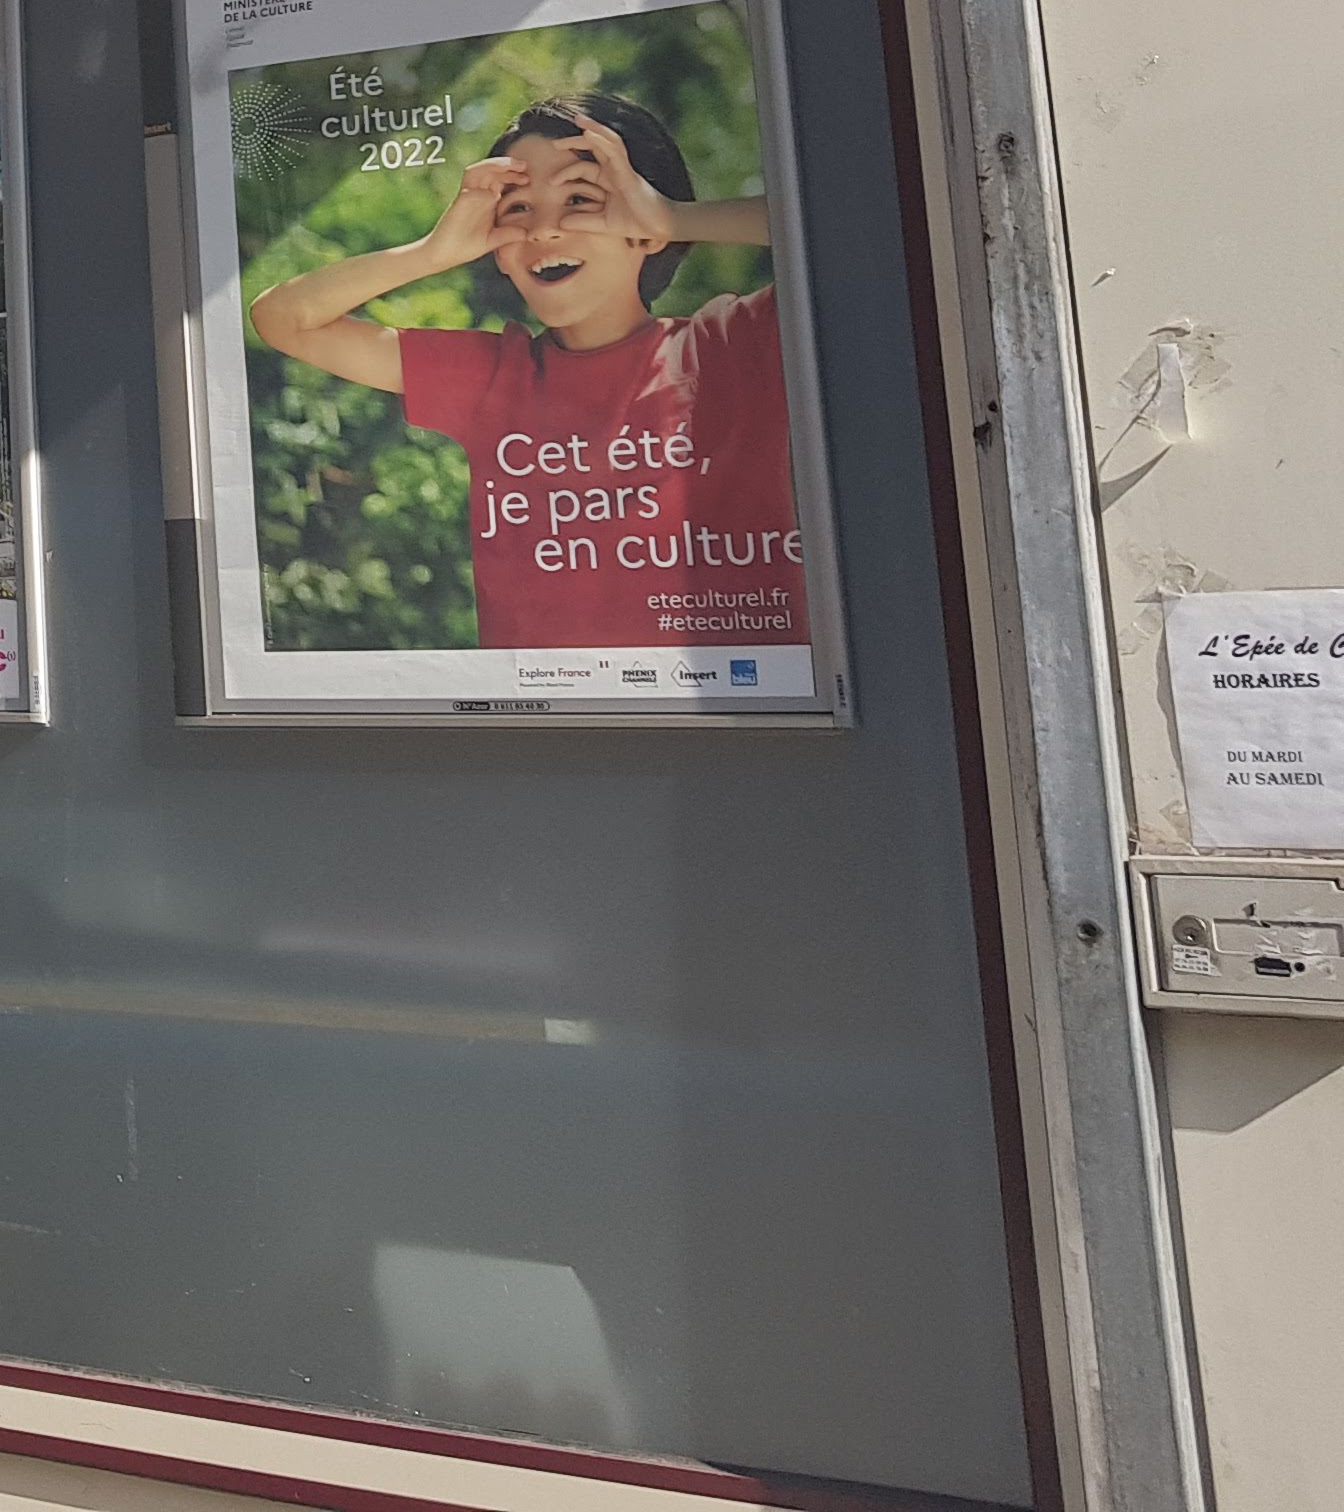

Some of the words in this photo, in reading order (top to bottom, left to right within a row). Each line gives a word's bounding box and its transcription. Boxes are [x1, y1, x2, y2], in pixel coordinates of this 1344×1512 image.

[223, 13, 239, 23] DE
[242, 9, 258, 20] LA
[260, 1, 313, 18] CULTURE
[329, 65, 383, 101] Été
[321, 94, 453, 139] culturel
[360, 135, 447, 172] 2022
[496, 433, 591, 477] Cet
[608, 422, 711, 475] été,
[480, 480, 530, 538] je
[548, 485, 660, 535] pars
[534, 537, 598, 571] en
[616, 520, 804, 569] culture
[647, 588, 789, 609] eteculturel.fr
[657, 611, 791, 630] #eteculturel
[1198, 634, 1286, 661] L'Epée
[1294, 636, 1319, 655] de
[518, 668, 555, 680] Explore
[558, 667, 591, 678] France
[1213, 673, 1320, 689] HORAIRES
[1227, 751, 1246, 762] DU
[1252, 751, 1303, 762] MARDI
[1227, 773, 1250, 785] AU
[1256, 773, 1324, 786] SAMEDI
